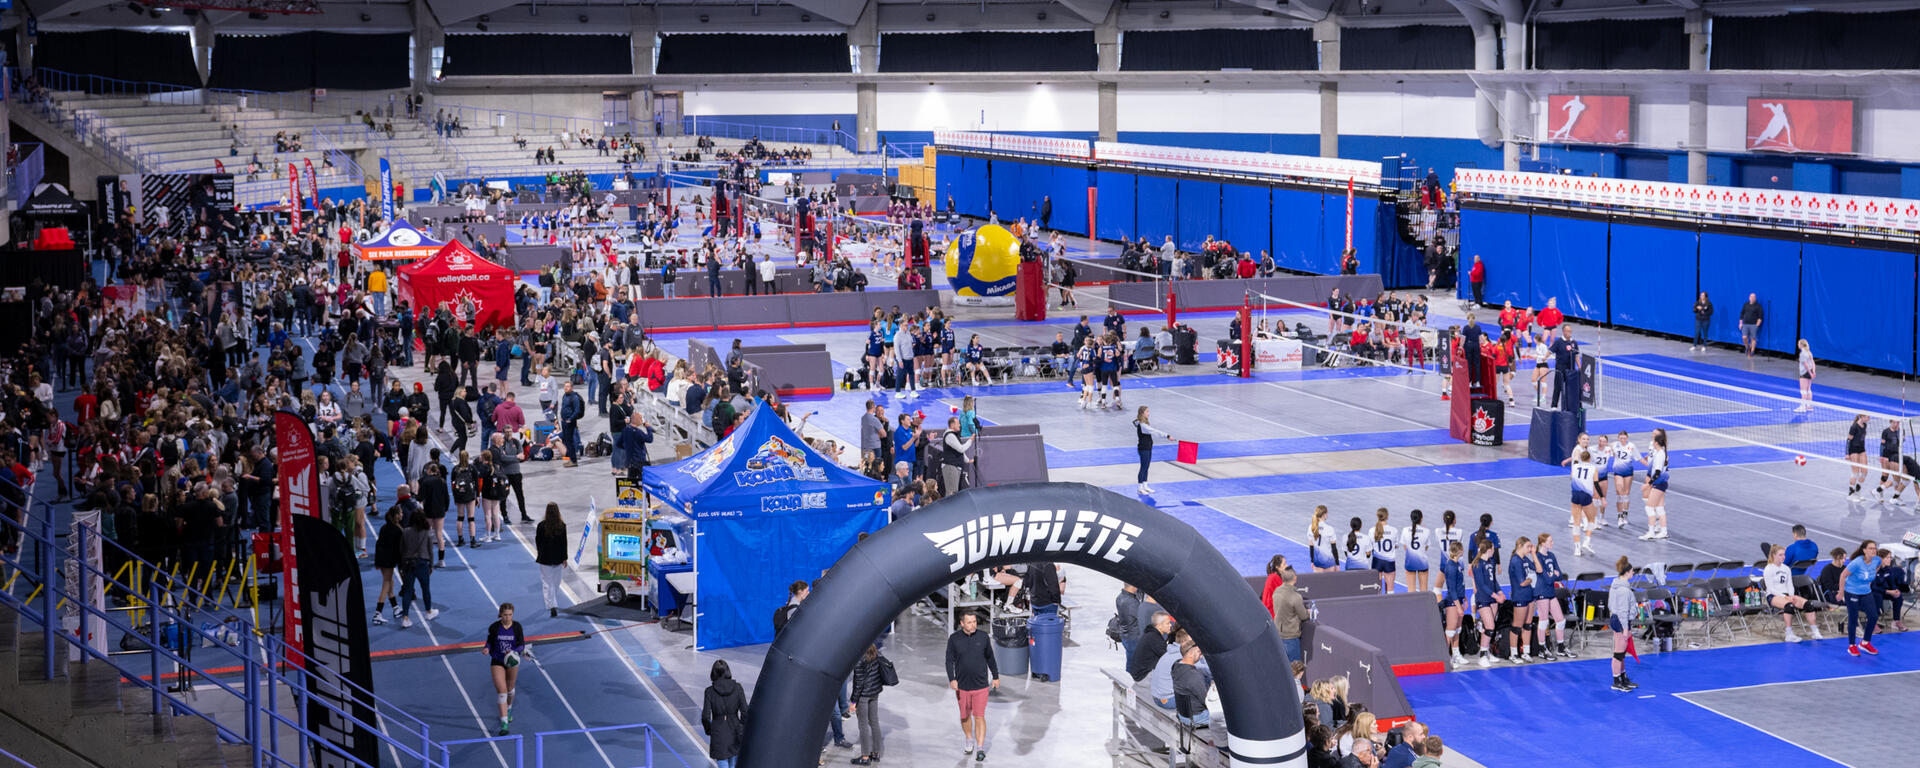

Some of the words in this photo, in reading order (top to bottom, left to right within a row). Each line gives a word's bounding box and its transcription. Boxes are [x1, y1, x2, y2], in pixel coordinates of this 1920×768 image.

[437, 274, 490, 283] volleyball.ca
[1441, 337, 1448, 350] 5
[1583, 364, 1592, 378] 4
[1596, 456, 1607, 465] 21
[1617, 450, 1628, 460] 12
[733, 464, 795, 487] KONA
[794, 466, 829, 482] ICE
[1576, 467, 1588, 480] 11
[761, 495, 803, 512] KONA
[802, 492, 827, 509] ICE
[922, 509, 1144, 574] JUMPLETE
[1377, 538, 1393, 552] 10
[1410, 536, 1421, 550] 6
